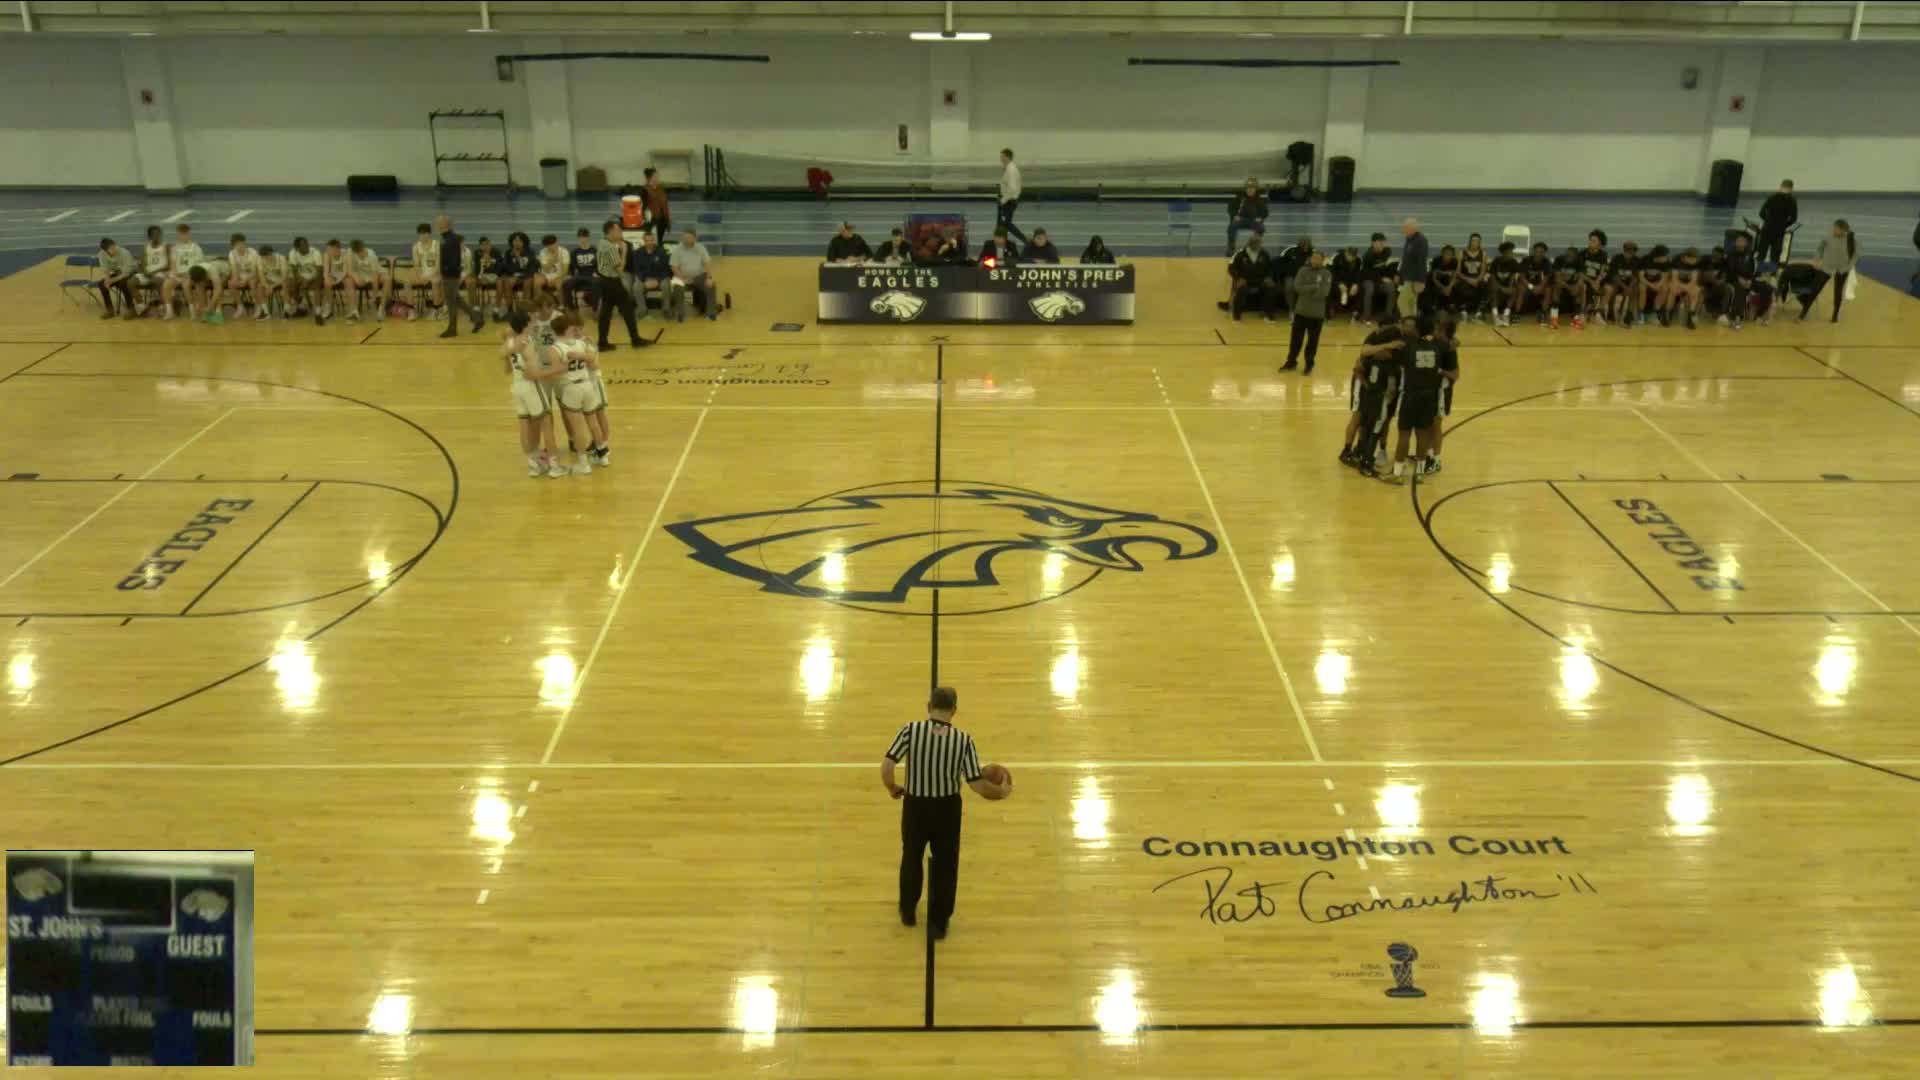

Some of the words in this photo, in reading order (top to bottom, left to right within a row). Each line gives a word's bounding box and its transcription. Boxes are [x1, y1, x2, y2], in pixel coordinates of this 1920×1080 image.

[864, 268, 894, 277] HOME
[897, 269, 910, 277] OF
[915, 268, 934, 277] THE
[989, 269, 1013, 281] ST.
[1018, 269, 1078, 281] JOHN'S
[1083, 269, 1126, 281] PREP
[858, 276, 940, 289] EAGLES
[1016, 281, 1099, 289] ATHLETICS
[678, 376, 831, 386] Connaughton
[115, 498, 255, 592] EAGLES
[1613, 498, 1745, 592] EAGLES
[1142, 835, 1436, 862] Connaughton
[1448, 833, 1573, 856] Court
[1152, 866, 1289, 926] Pat
[1299, 870, 1560, 924] Connaughton
[167, 934, 225, 958] GUEST
[192, 1010, 232, 1029] FOULS
